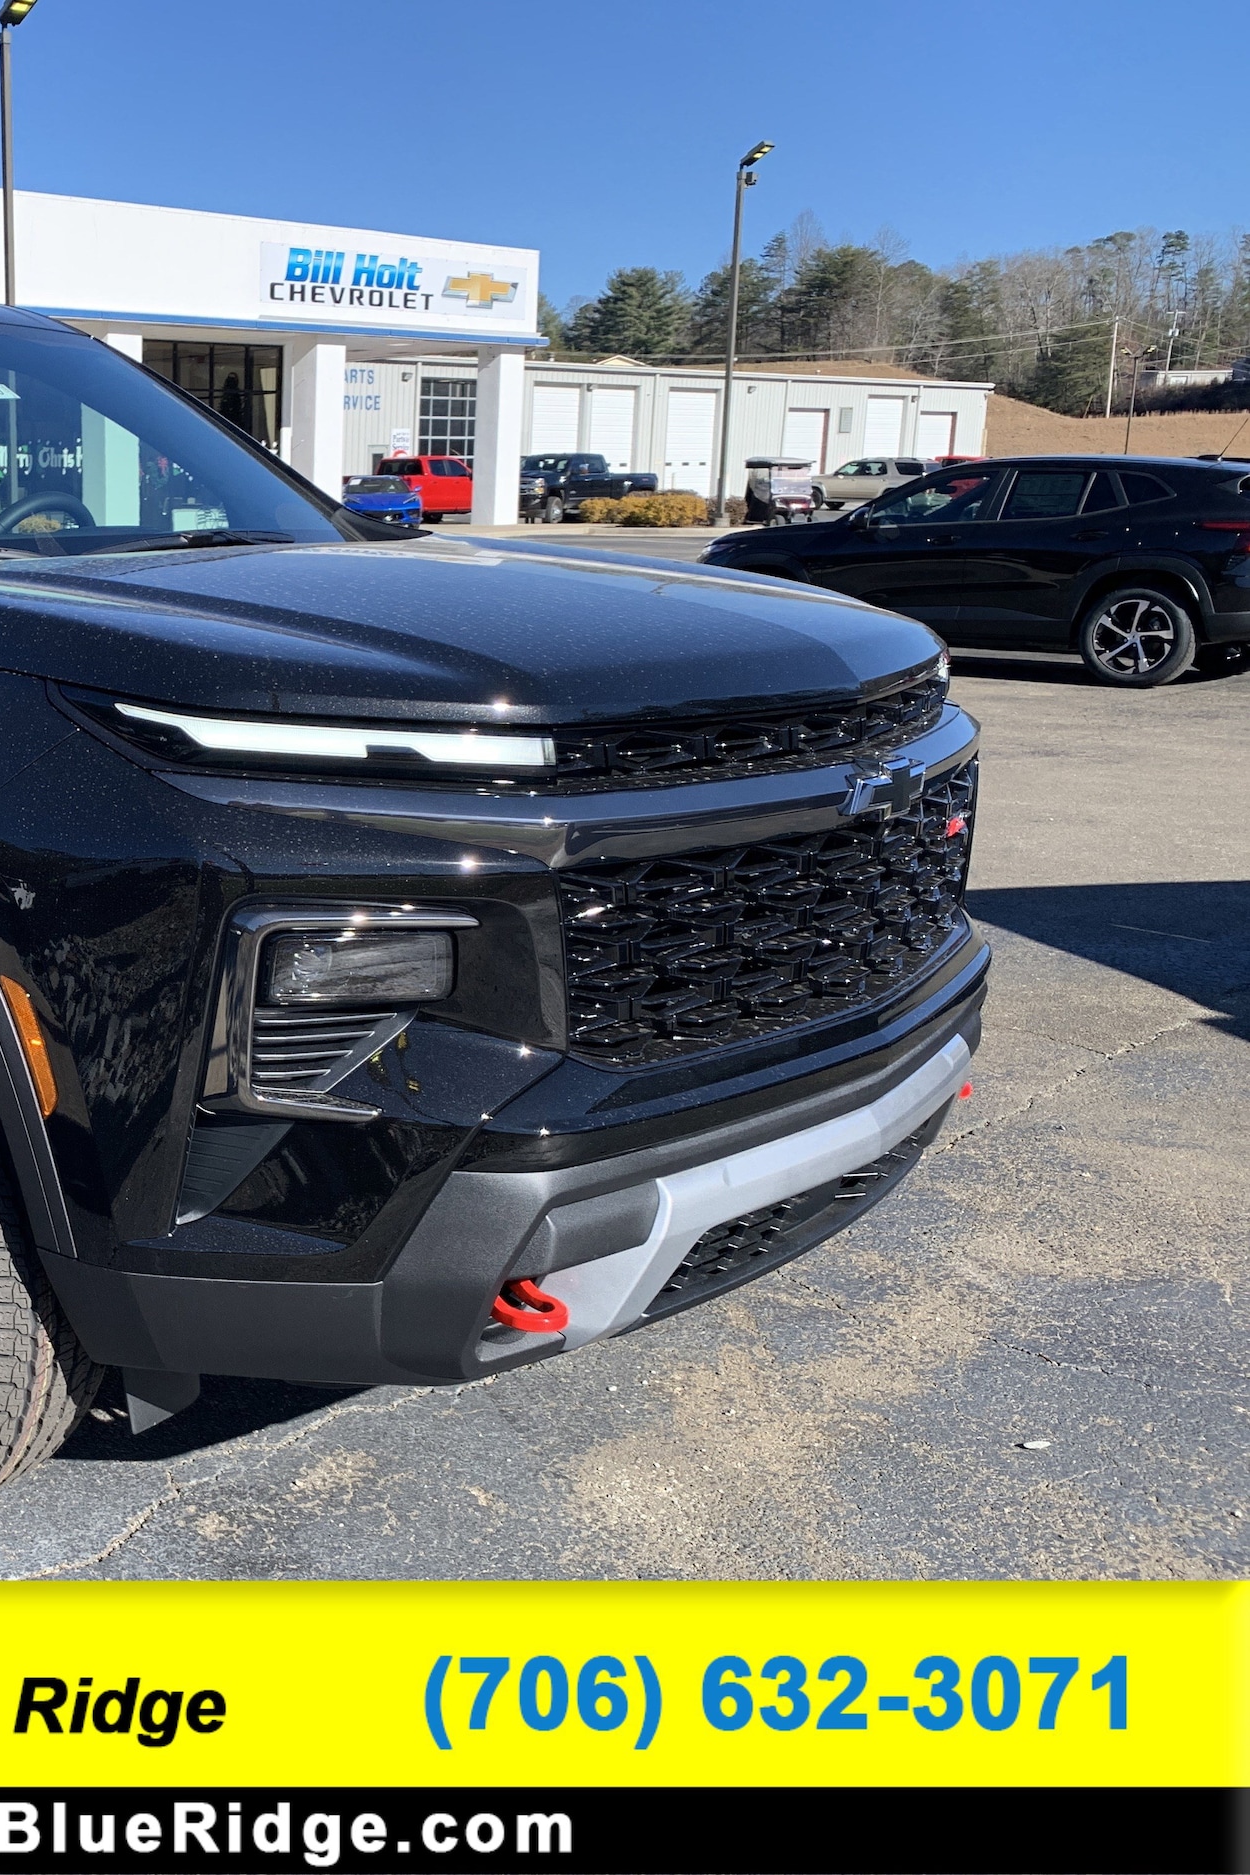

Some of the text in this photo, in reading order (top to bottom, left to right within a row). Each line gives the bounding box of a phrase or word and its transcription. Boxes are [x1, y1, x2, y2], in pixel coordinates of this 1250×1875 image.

[284, 247, 423, 291] Bill Holt
[269, 282, 434, 310] CHEVROLET
[345, 369, 374, 384] ARTS
[344, 395, 381, 410] RVICE
[38, 445, 82, 468] Christ
